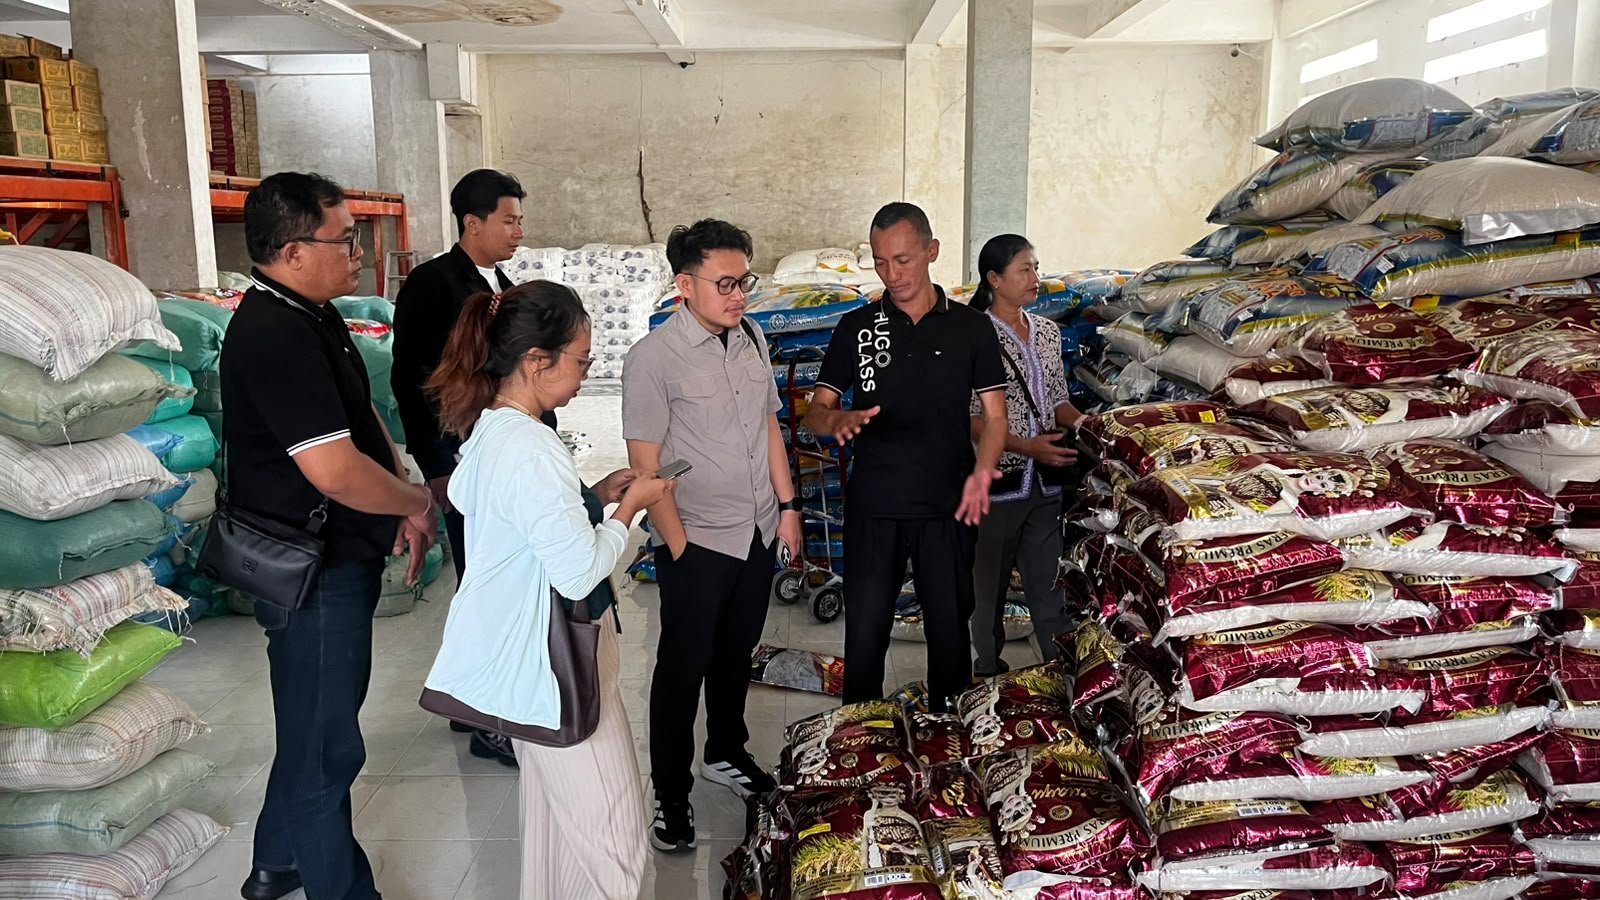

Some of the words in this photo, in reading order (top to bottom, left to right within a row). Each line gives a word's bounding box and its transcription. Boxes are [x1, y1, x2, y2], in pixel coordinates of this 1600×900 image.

[874, 312, 892, 368] HUGO
[857, 328, 876, 393] CLASS
[1413, 471, 1469, 484] PREMIU
[1473, 470, 1506, 483] ERAS
[1204, 628, 1274, 642] PREMIUM
[1020, 830, 1081, 848] PREMIUM
